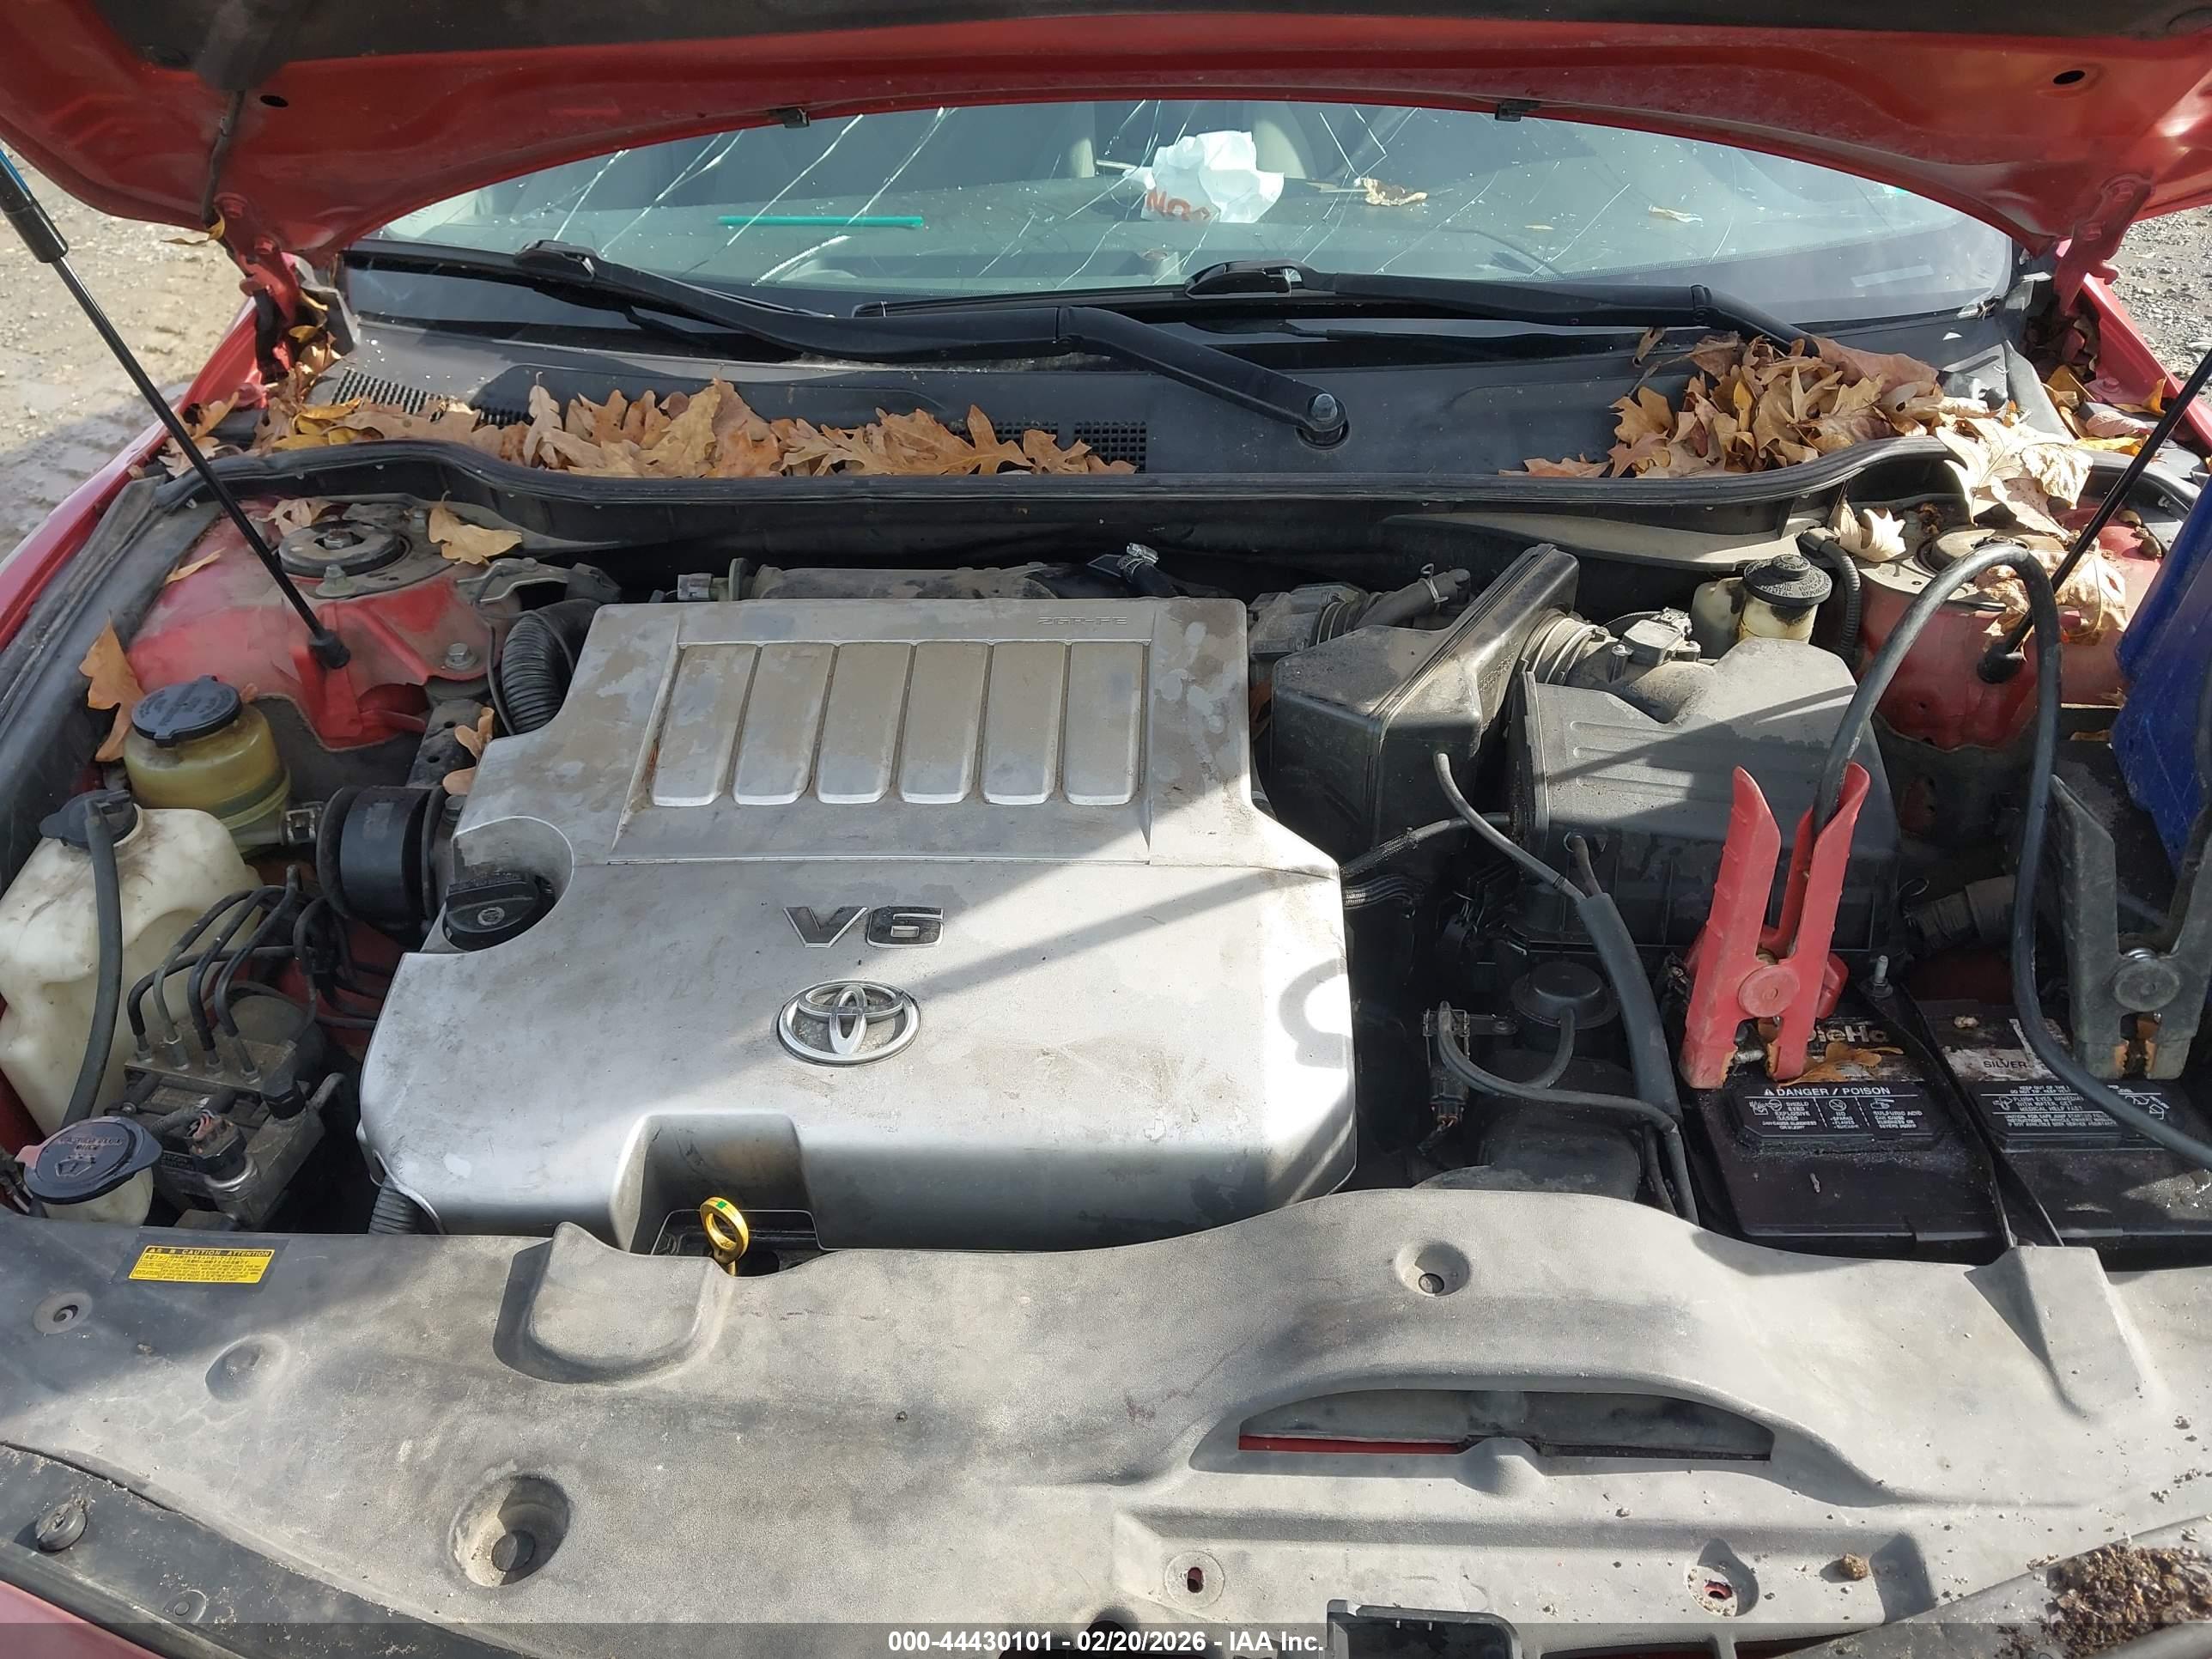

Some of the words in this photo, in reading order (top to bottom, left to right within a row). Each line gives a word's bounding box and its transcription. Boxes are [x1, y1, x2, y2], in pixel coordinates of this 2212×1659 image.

[1037, 617, 1127, 626] 2GR-FE
[783, 906, 945, 949] V6
[1984, 1060, 2027, 1069] SILVER
[1777, 1088, 1829, 1097] DANGER
[1843, 1086, 1891, 1096] POISON
